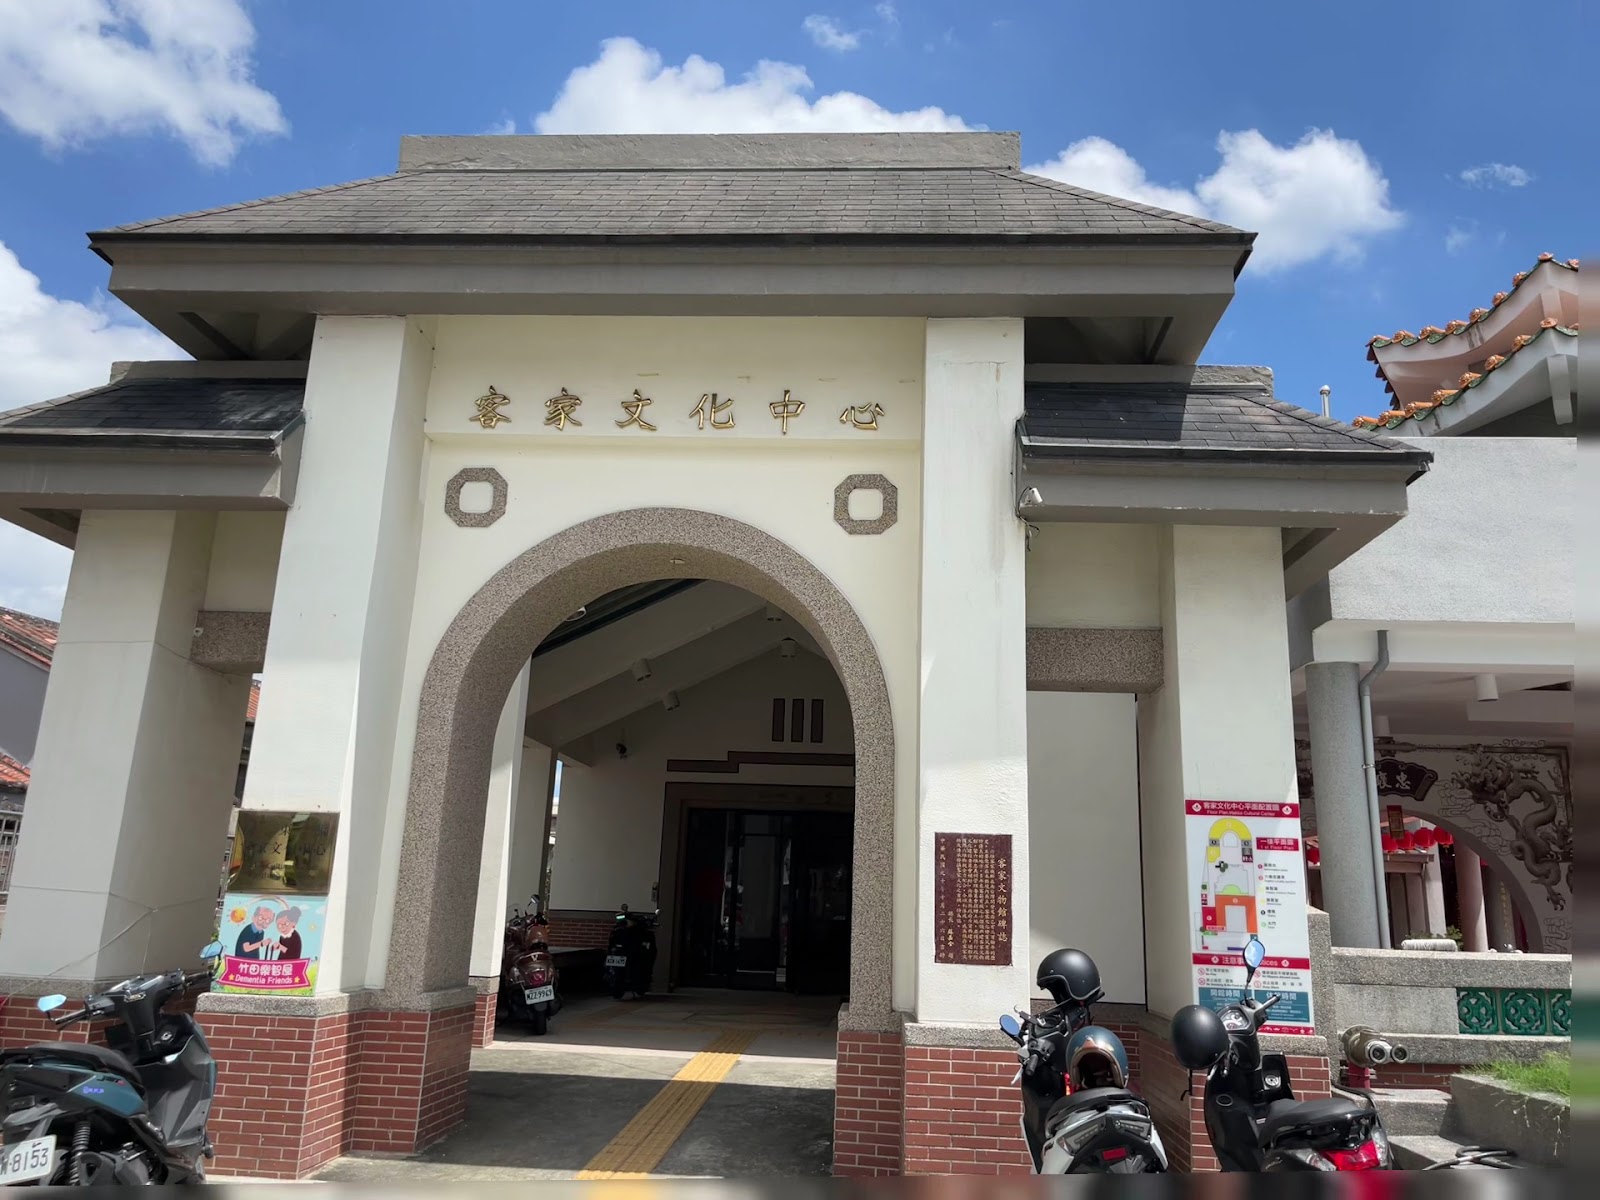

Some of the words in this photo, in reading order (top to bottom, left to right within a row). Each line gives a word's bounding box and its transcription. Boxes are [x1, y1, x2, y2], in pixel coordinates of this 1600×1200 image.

[468, 385, 886, 436] 客家文化中心
[239, 963, 293, 976] 竹田樂智屋
[235, 974, 266, 984] Dementia
[267, 976, 293, 984] Friends
